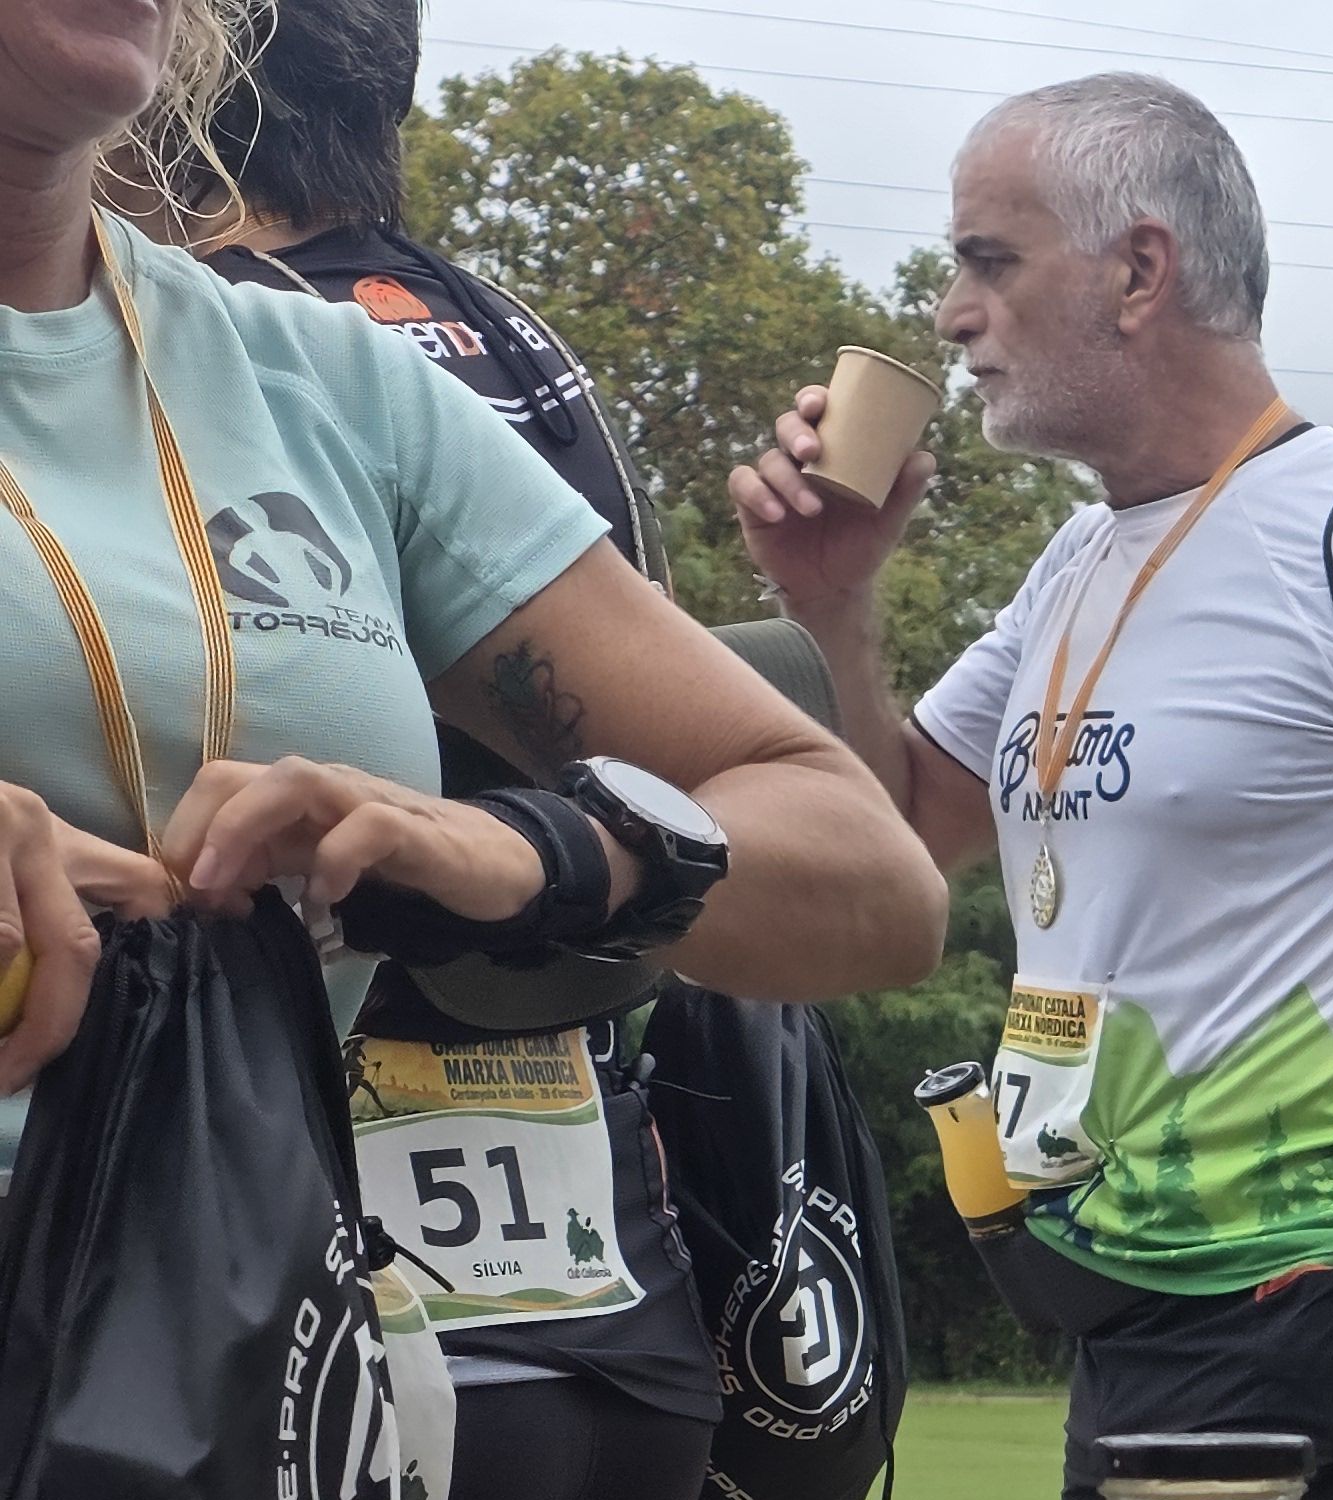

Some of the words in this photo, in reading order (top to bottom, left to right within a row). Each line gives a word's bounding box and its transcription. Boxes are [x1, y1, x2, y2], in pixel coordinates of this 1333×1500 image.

[443, 1059, 510, 1085] MARXA
[409, 1145, 548, 1248] 51
[473, 1258, 523, 1278] SÍLVIA
